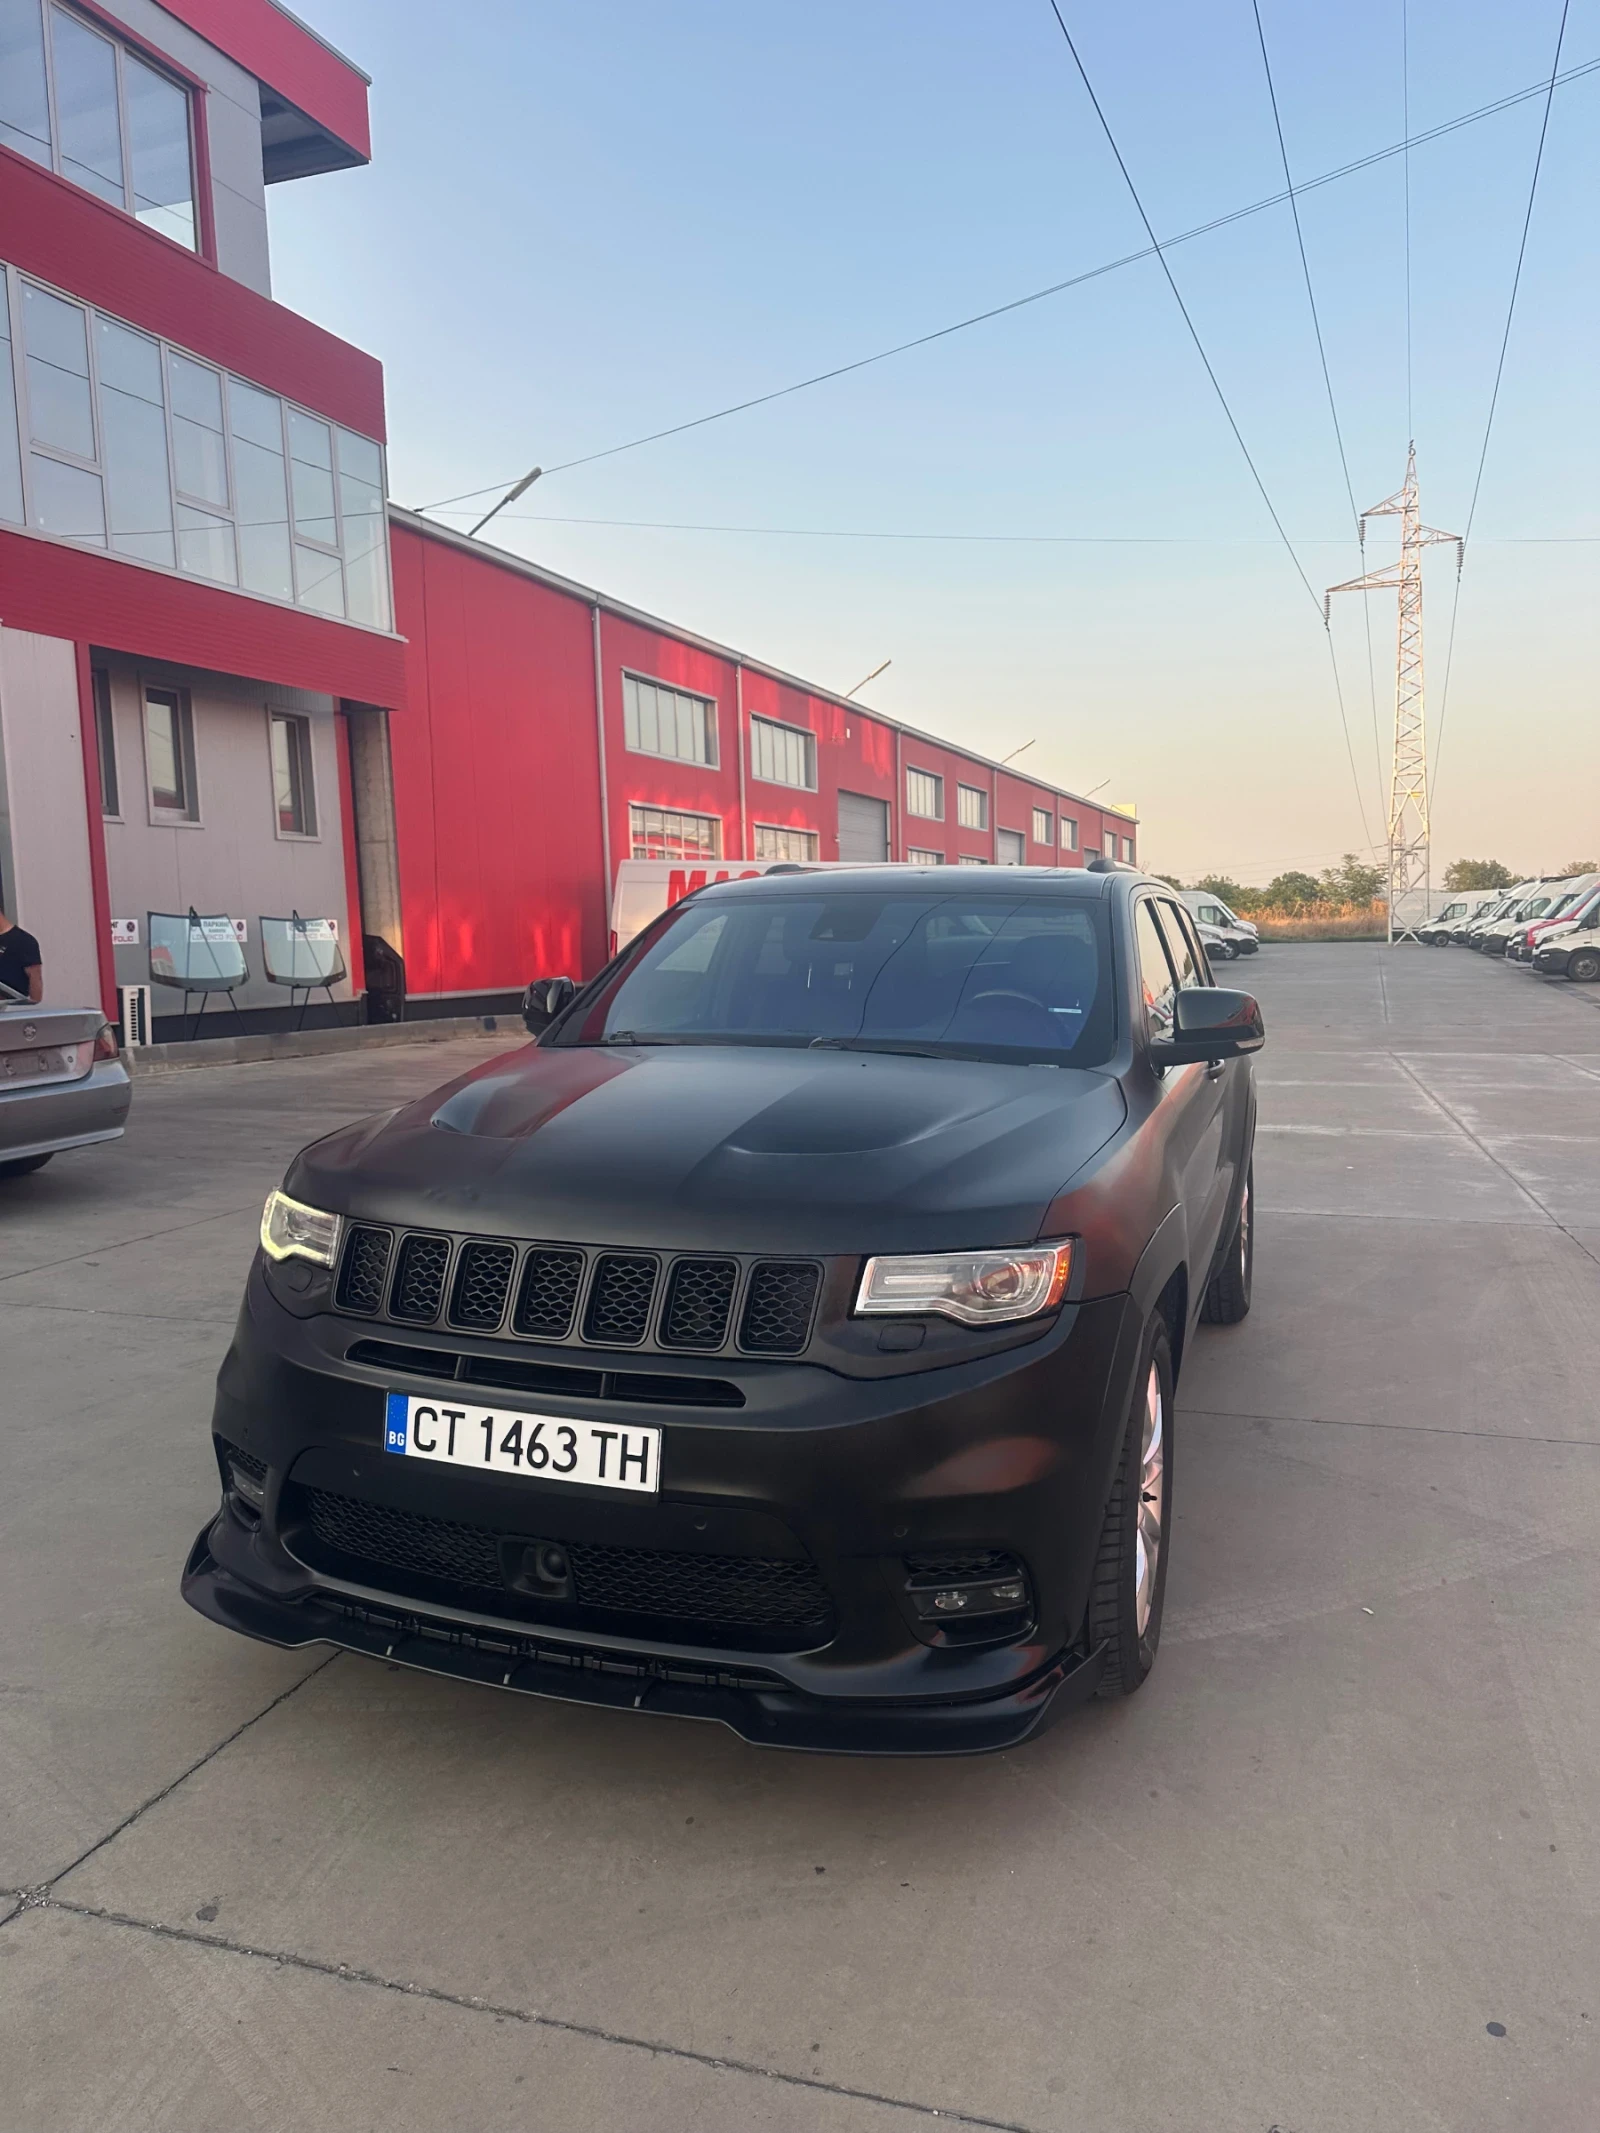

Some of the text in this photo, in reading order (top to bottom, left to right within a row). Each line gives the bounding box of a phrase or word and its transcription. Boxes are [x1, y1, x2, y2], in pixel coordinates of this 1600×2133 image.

[389, 1430, 405, 1446] BG
[413, 1406, 650, 1484] CT 1463 TH
